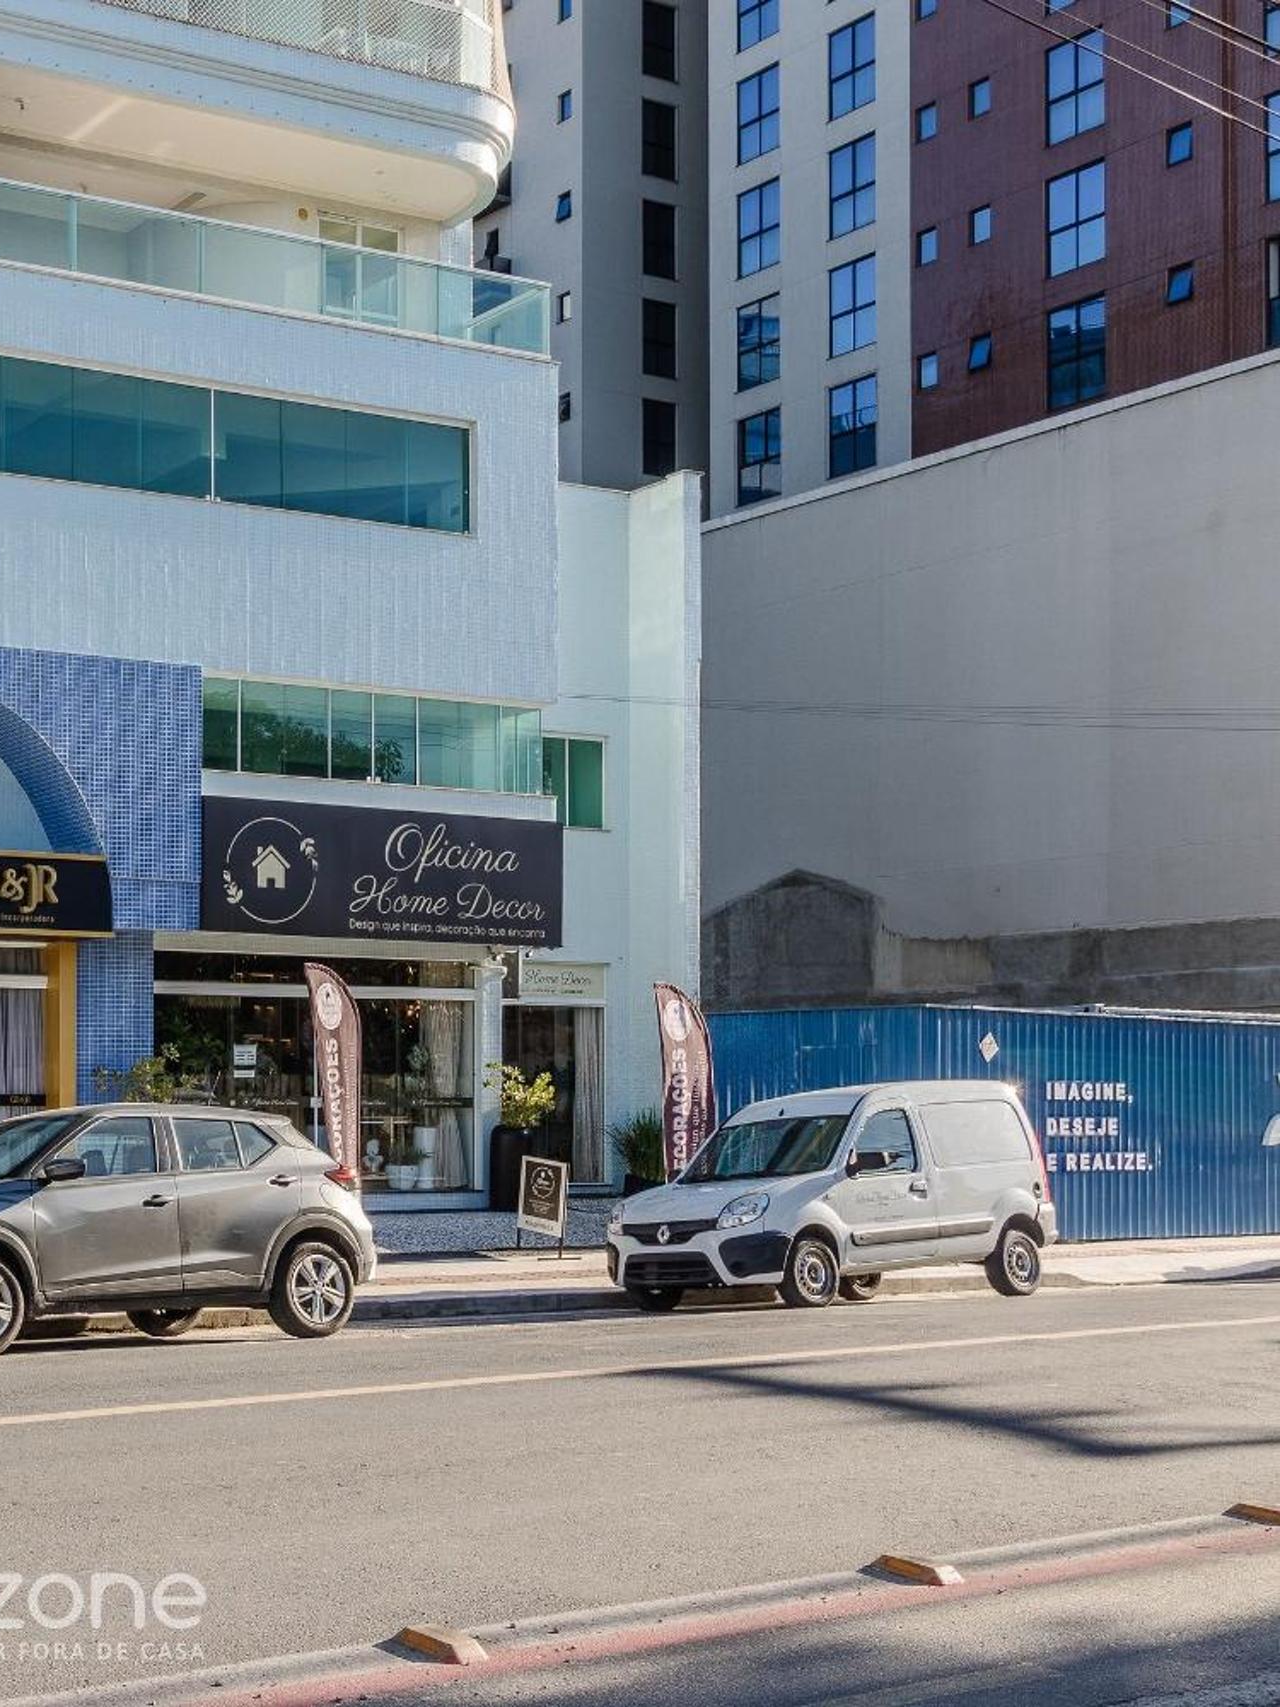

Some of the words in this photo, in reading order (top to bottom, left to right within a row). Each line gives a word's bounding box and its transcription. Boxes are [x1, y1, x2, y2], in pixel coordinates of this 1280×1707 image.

[384, 822, 521, 884] Oficina
[349, 875, 450, 916] Home
[456, 883, 546, 921] Decor
[348, 918, 381, 931] Design
[382, 922, 402, 933] que
[1046, 1082, 1134, 1104] IMAGINE,
[1046, 1117, 1119, 1136] DESEJE
[1046, 1153, 1057, 1172] E
[1066, 1152, 1153, 1172] REALIZE.
